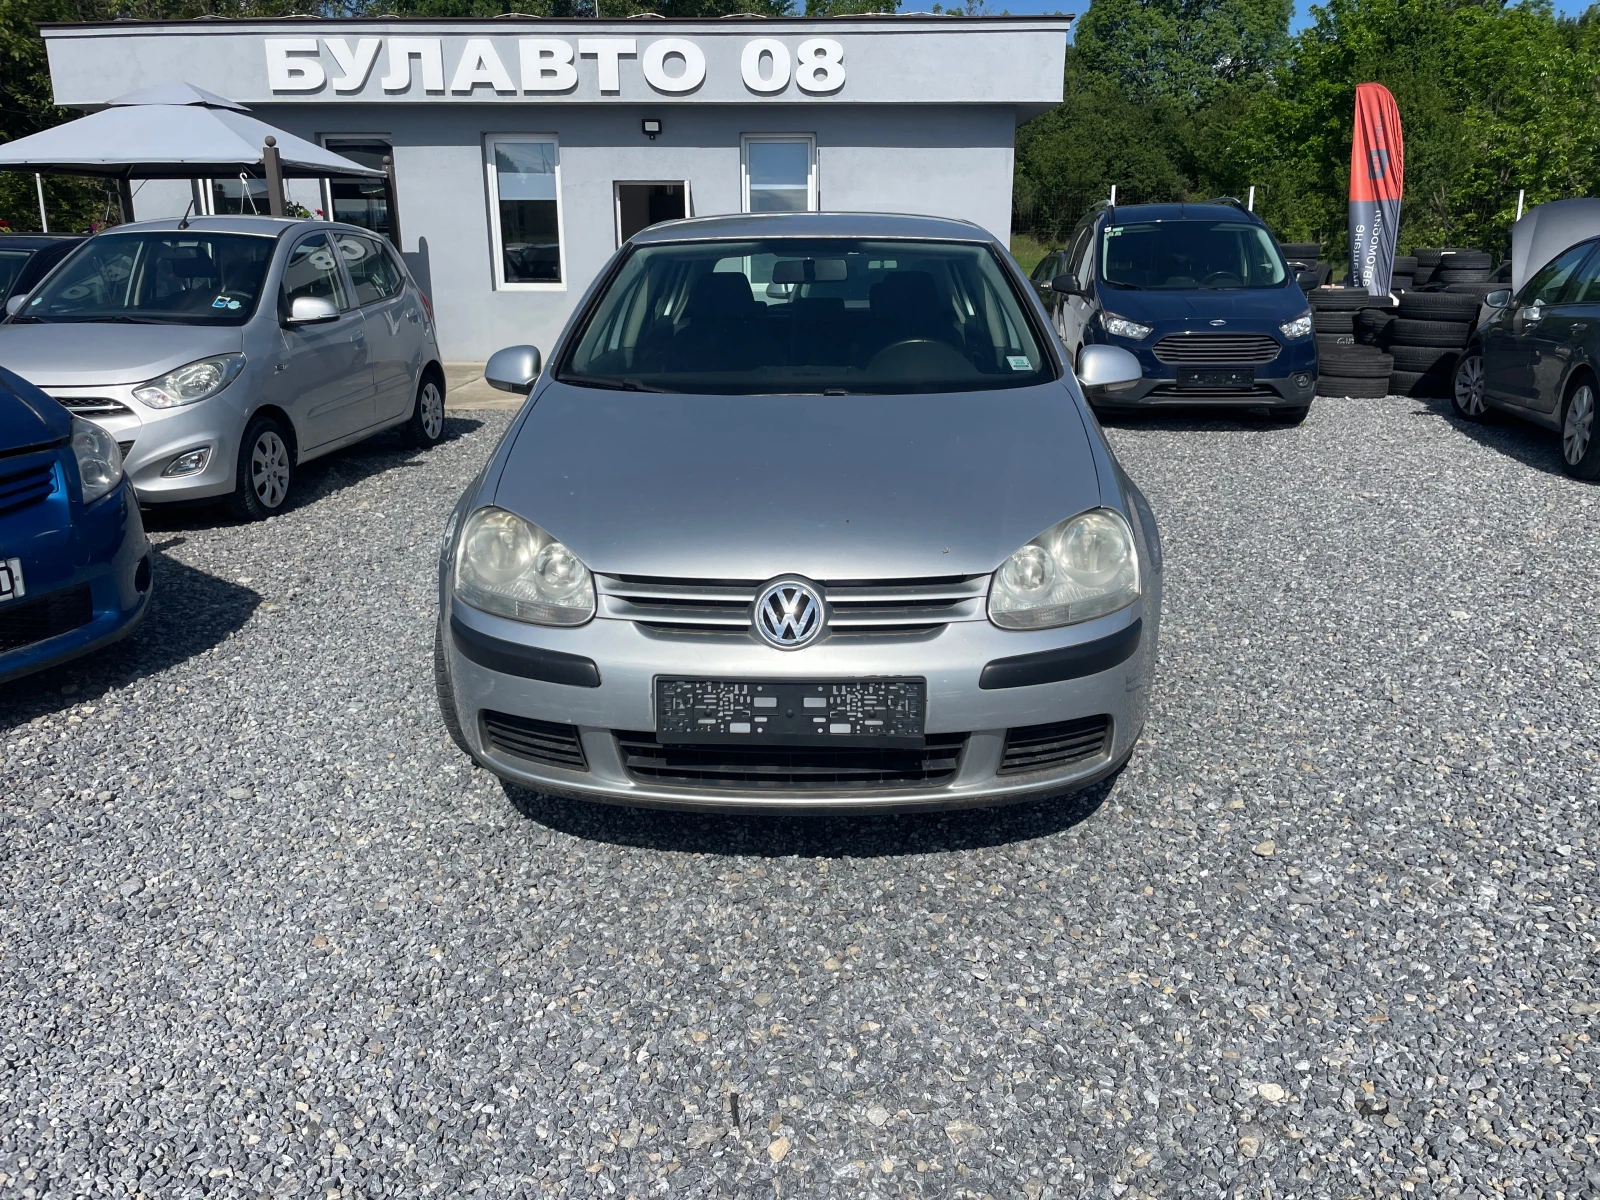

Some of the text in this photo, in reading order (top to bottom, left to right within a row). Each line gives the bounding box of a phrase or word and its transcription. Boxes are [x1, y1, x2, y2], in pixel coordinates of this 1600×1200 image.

[264, 38, 846, 93] БУЛАВТО 08
[758, 584, 820, 645] VW
